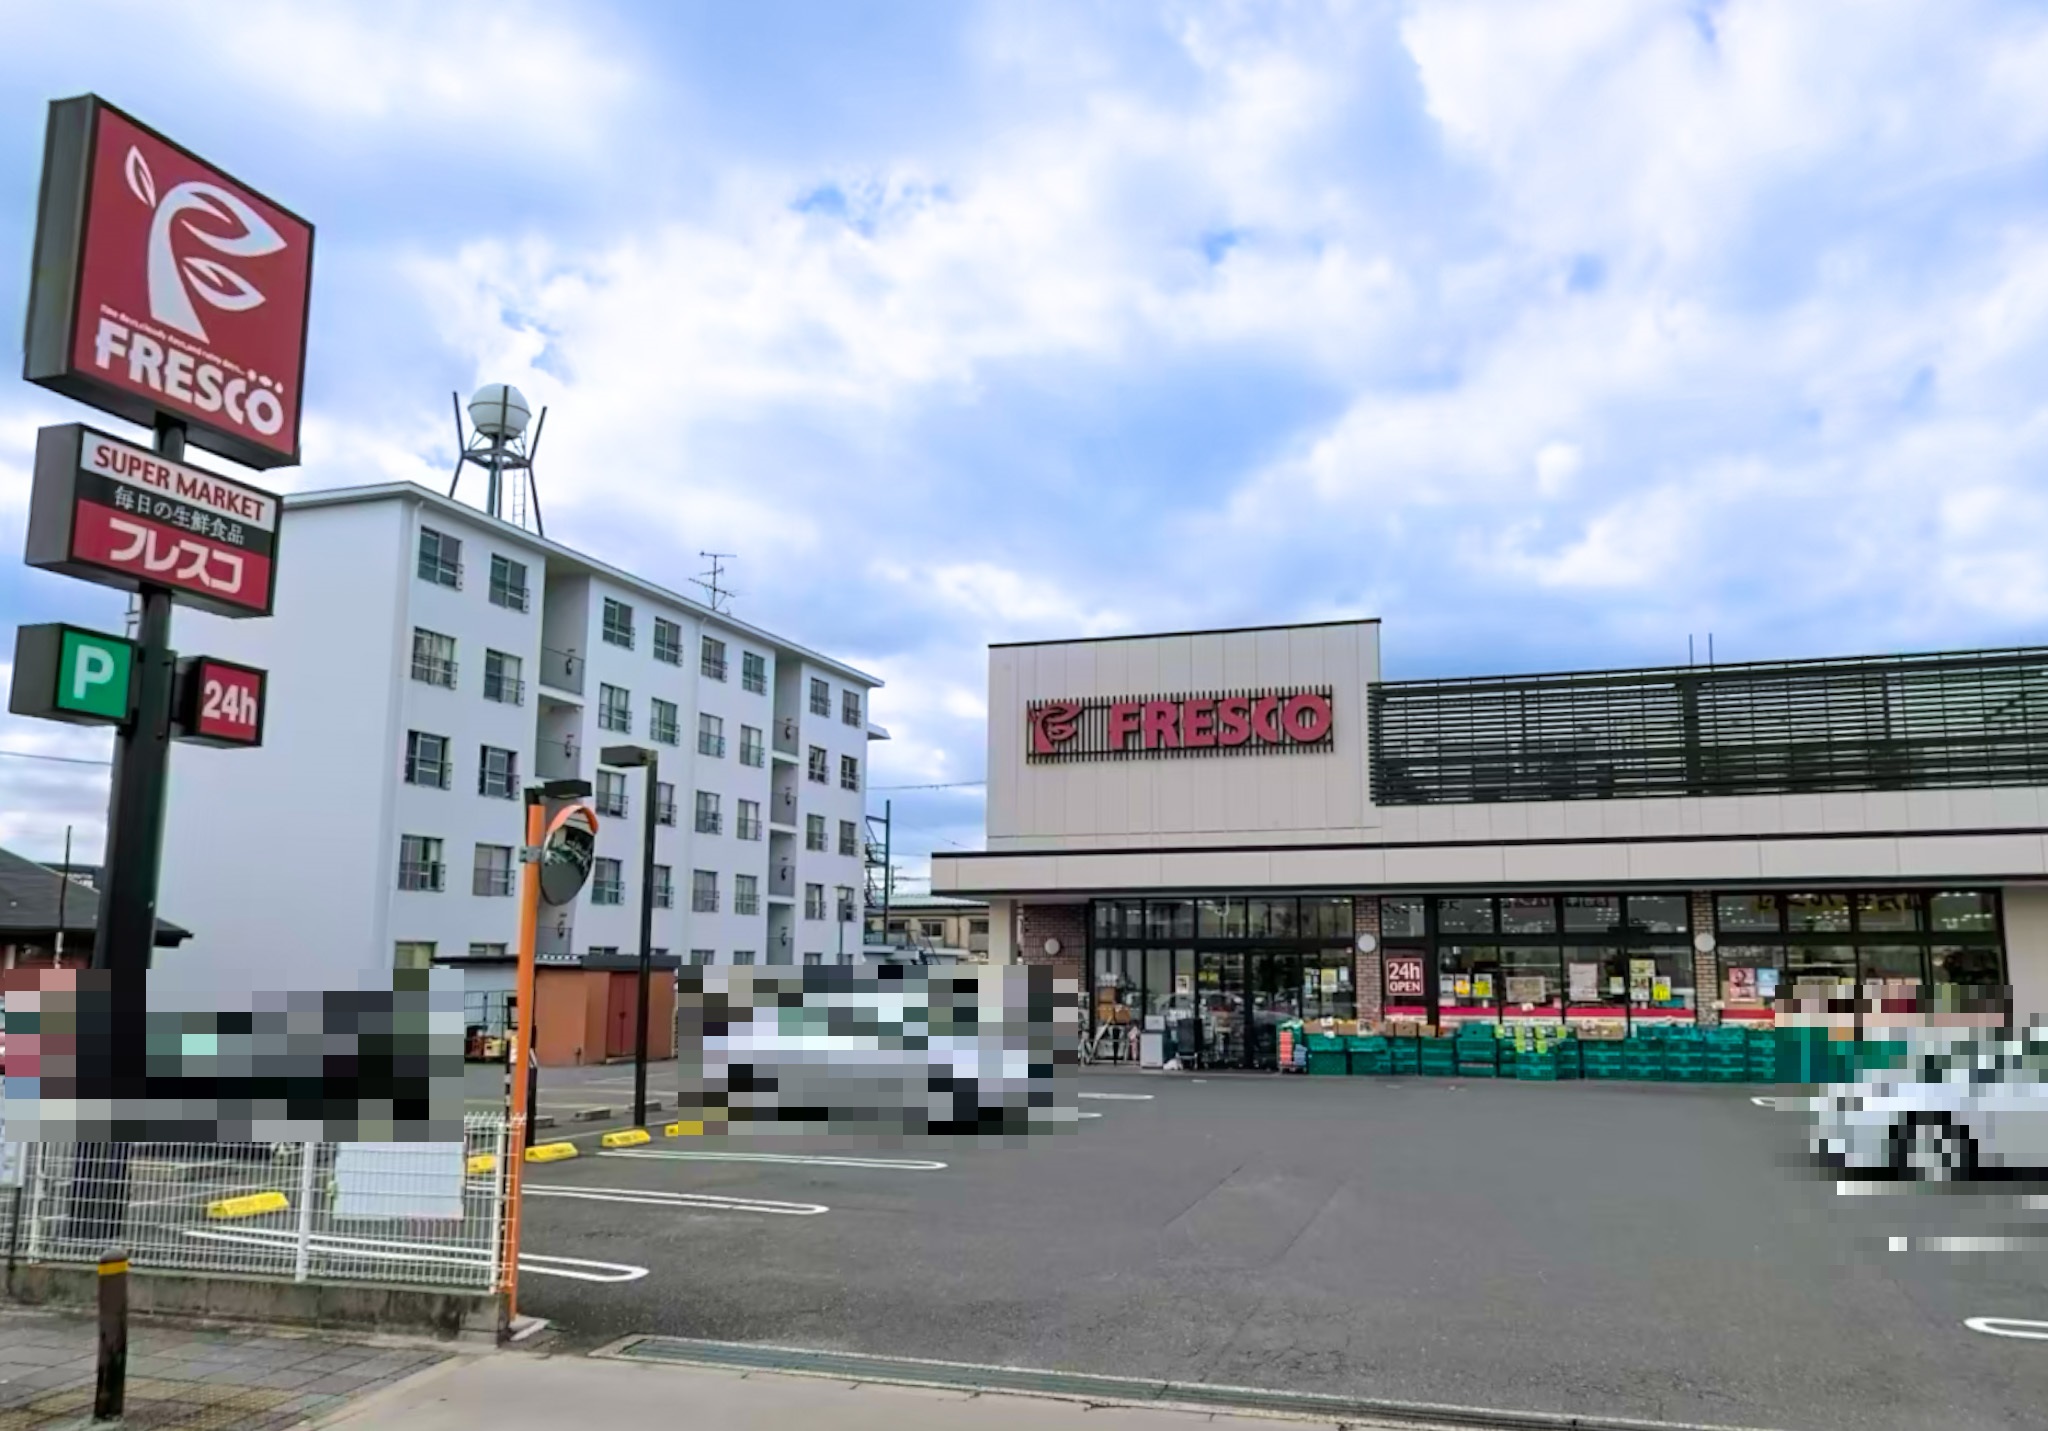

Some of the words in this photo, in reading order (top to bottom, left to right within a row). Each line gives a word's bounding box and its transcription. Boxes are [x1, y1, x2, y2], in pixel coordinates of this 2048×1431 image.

[95, 318, 284, 436] FRESCO
[94, 445, 170, 490] SUPER
[176, 472, 265, 521] MARKET
[115, 485, 245, 545] 毎日の生鮮食品
[109, 517, 243, 594] フレスコ
[73, 644, 115, 699] P
[202, 680, 257, 726] 24h
[1108, 693, 1332, 750] FRESCO
[1389, 962, 1420, 980] 24h
[1389, 981, 1420, 992] OPEN
